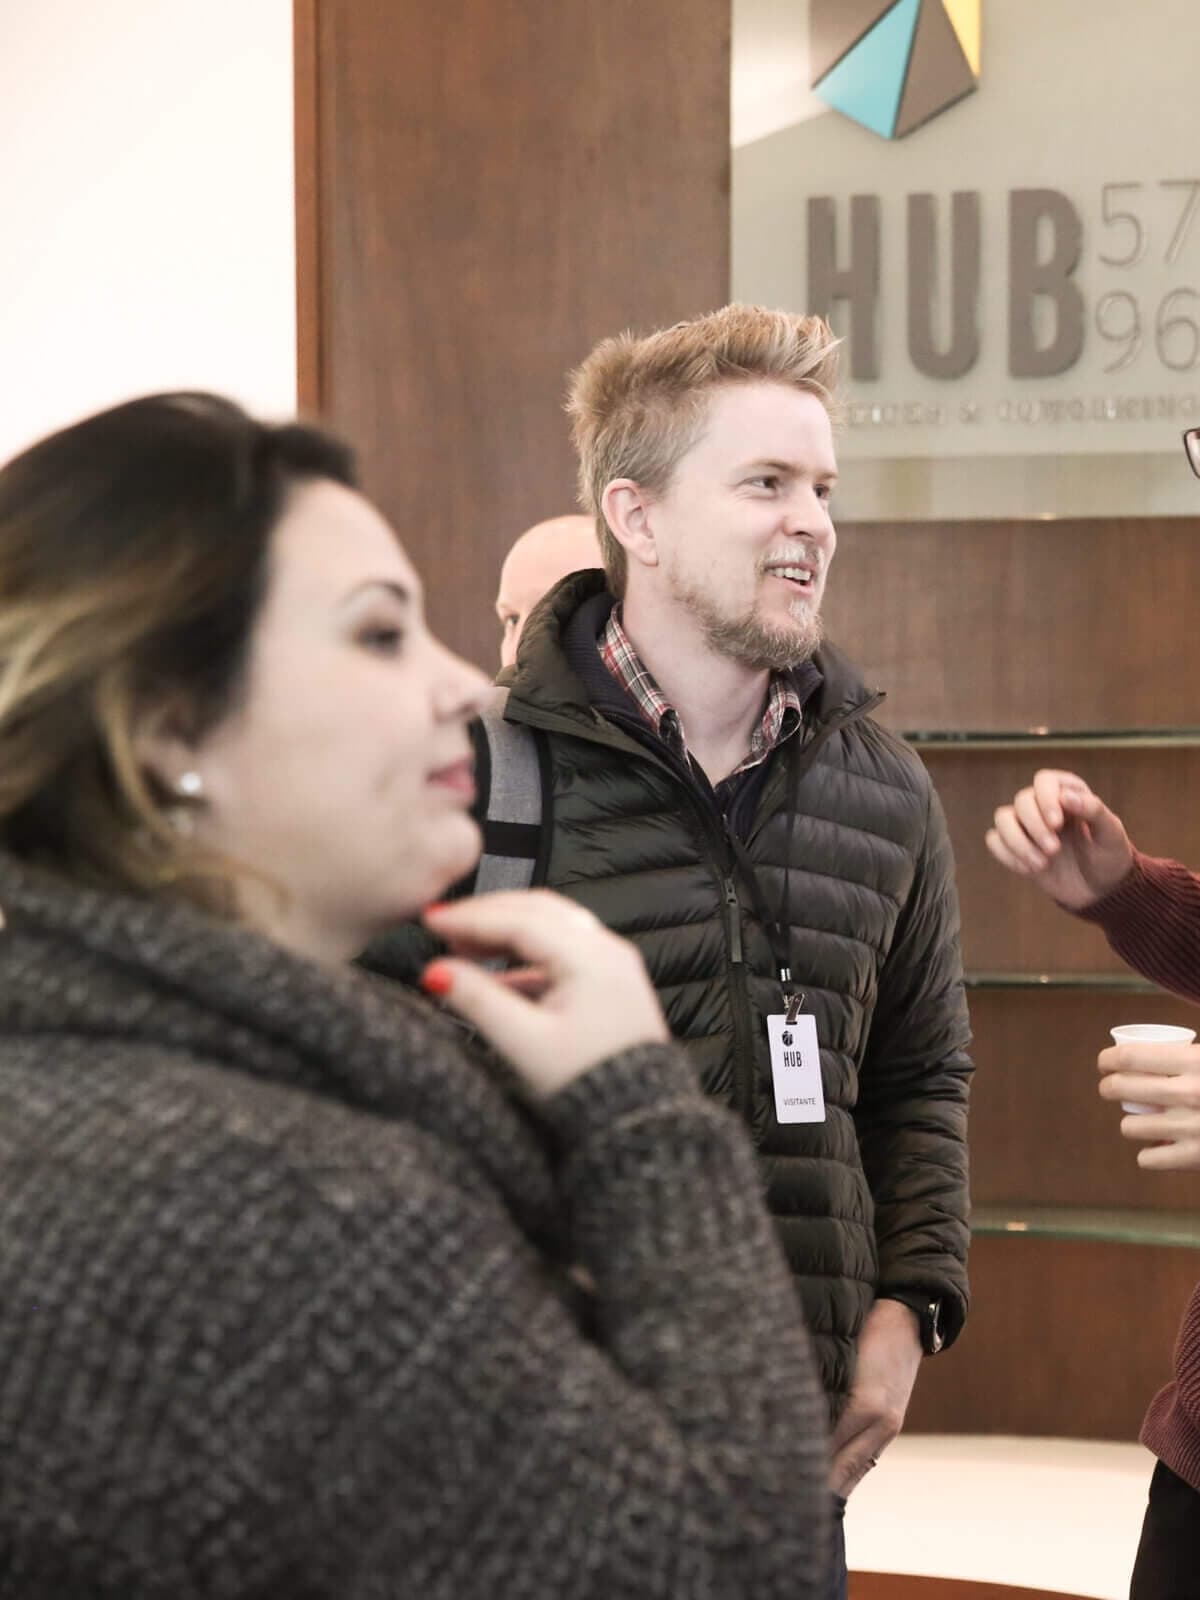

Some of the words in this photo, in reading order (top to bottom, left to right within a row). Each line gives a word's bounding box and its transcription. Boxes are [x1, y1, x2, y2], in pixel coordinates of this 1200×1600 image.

[807, 187, 1086, 382] HUB
[783, 1050, 803, 1068] HUB
[783, 1097, 817, 1106] VISITANTE
